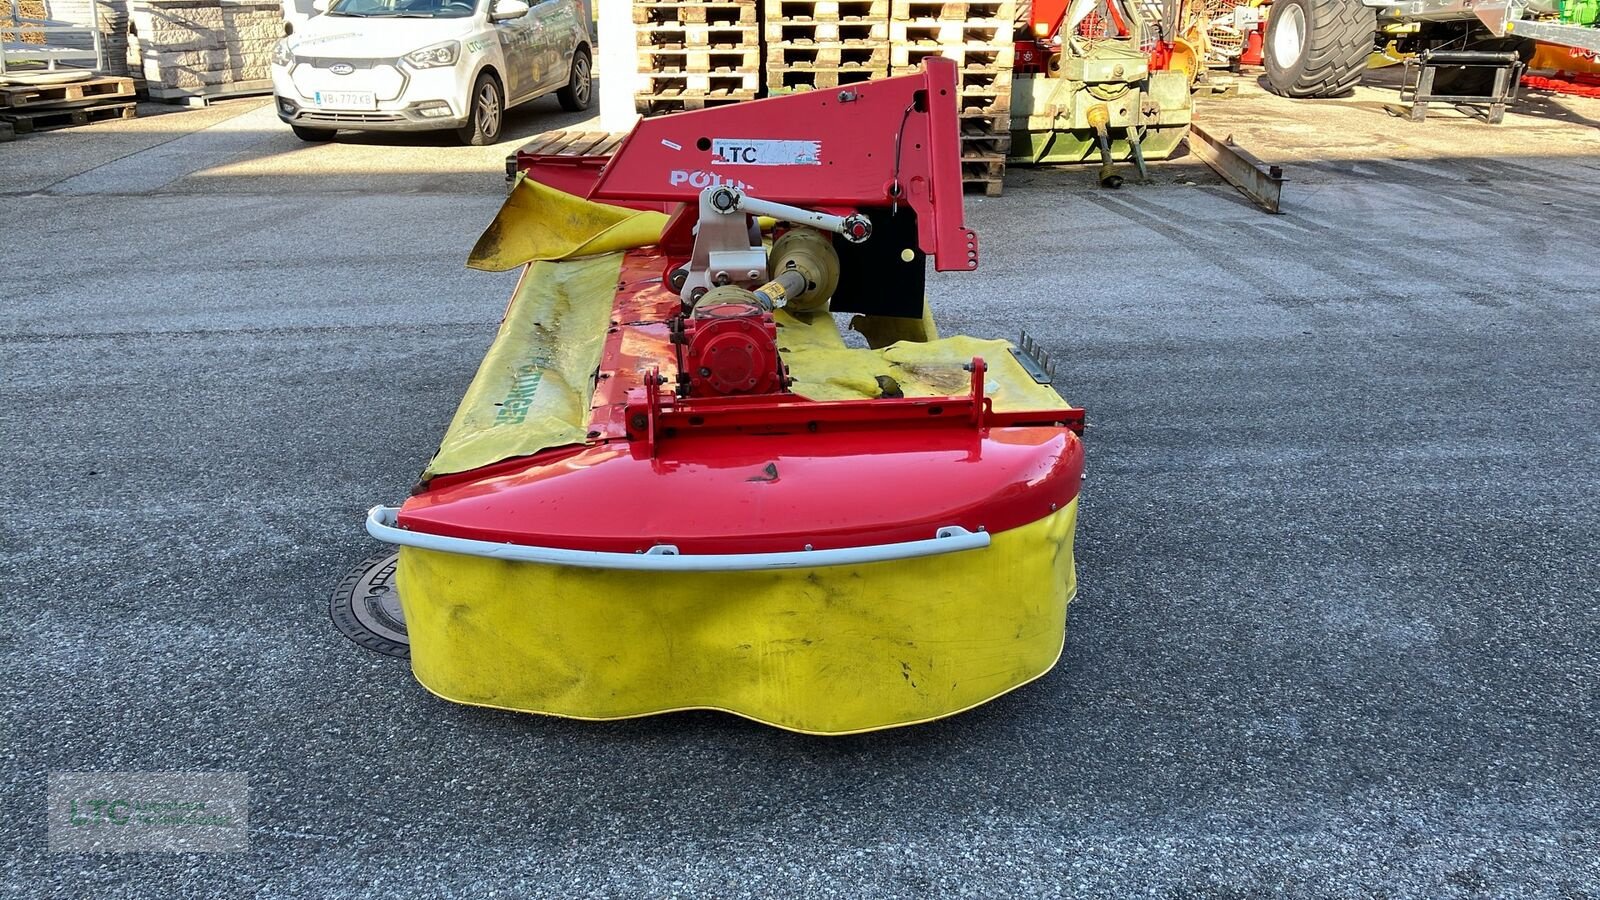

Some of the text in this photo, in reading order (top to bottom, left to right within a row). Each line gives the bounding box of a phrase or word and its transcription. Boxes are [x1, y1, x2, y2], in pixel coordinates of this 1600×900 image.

[466, 40, 482, 54] LTC
[322, 93, 334, 104] VB
[719, 146, 757, 163] LTC
